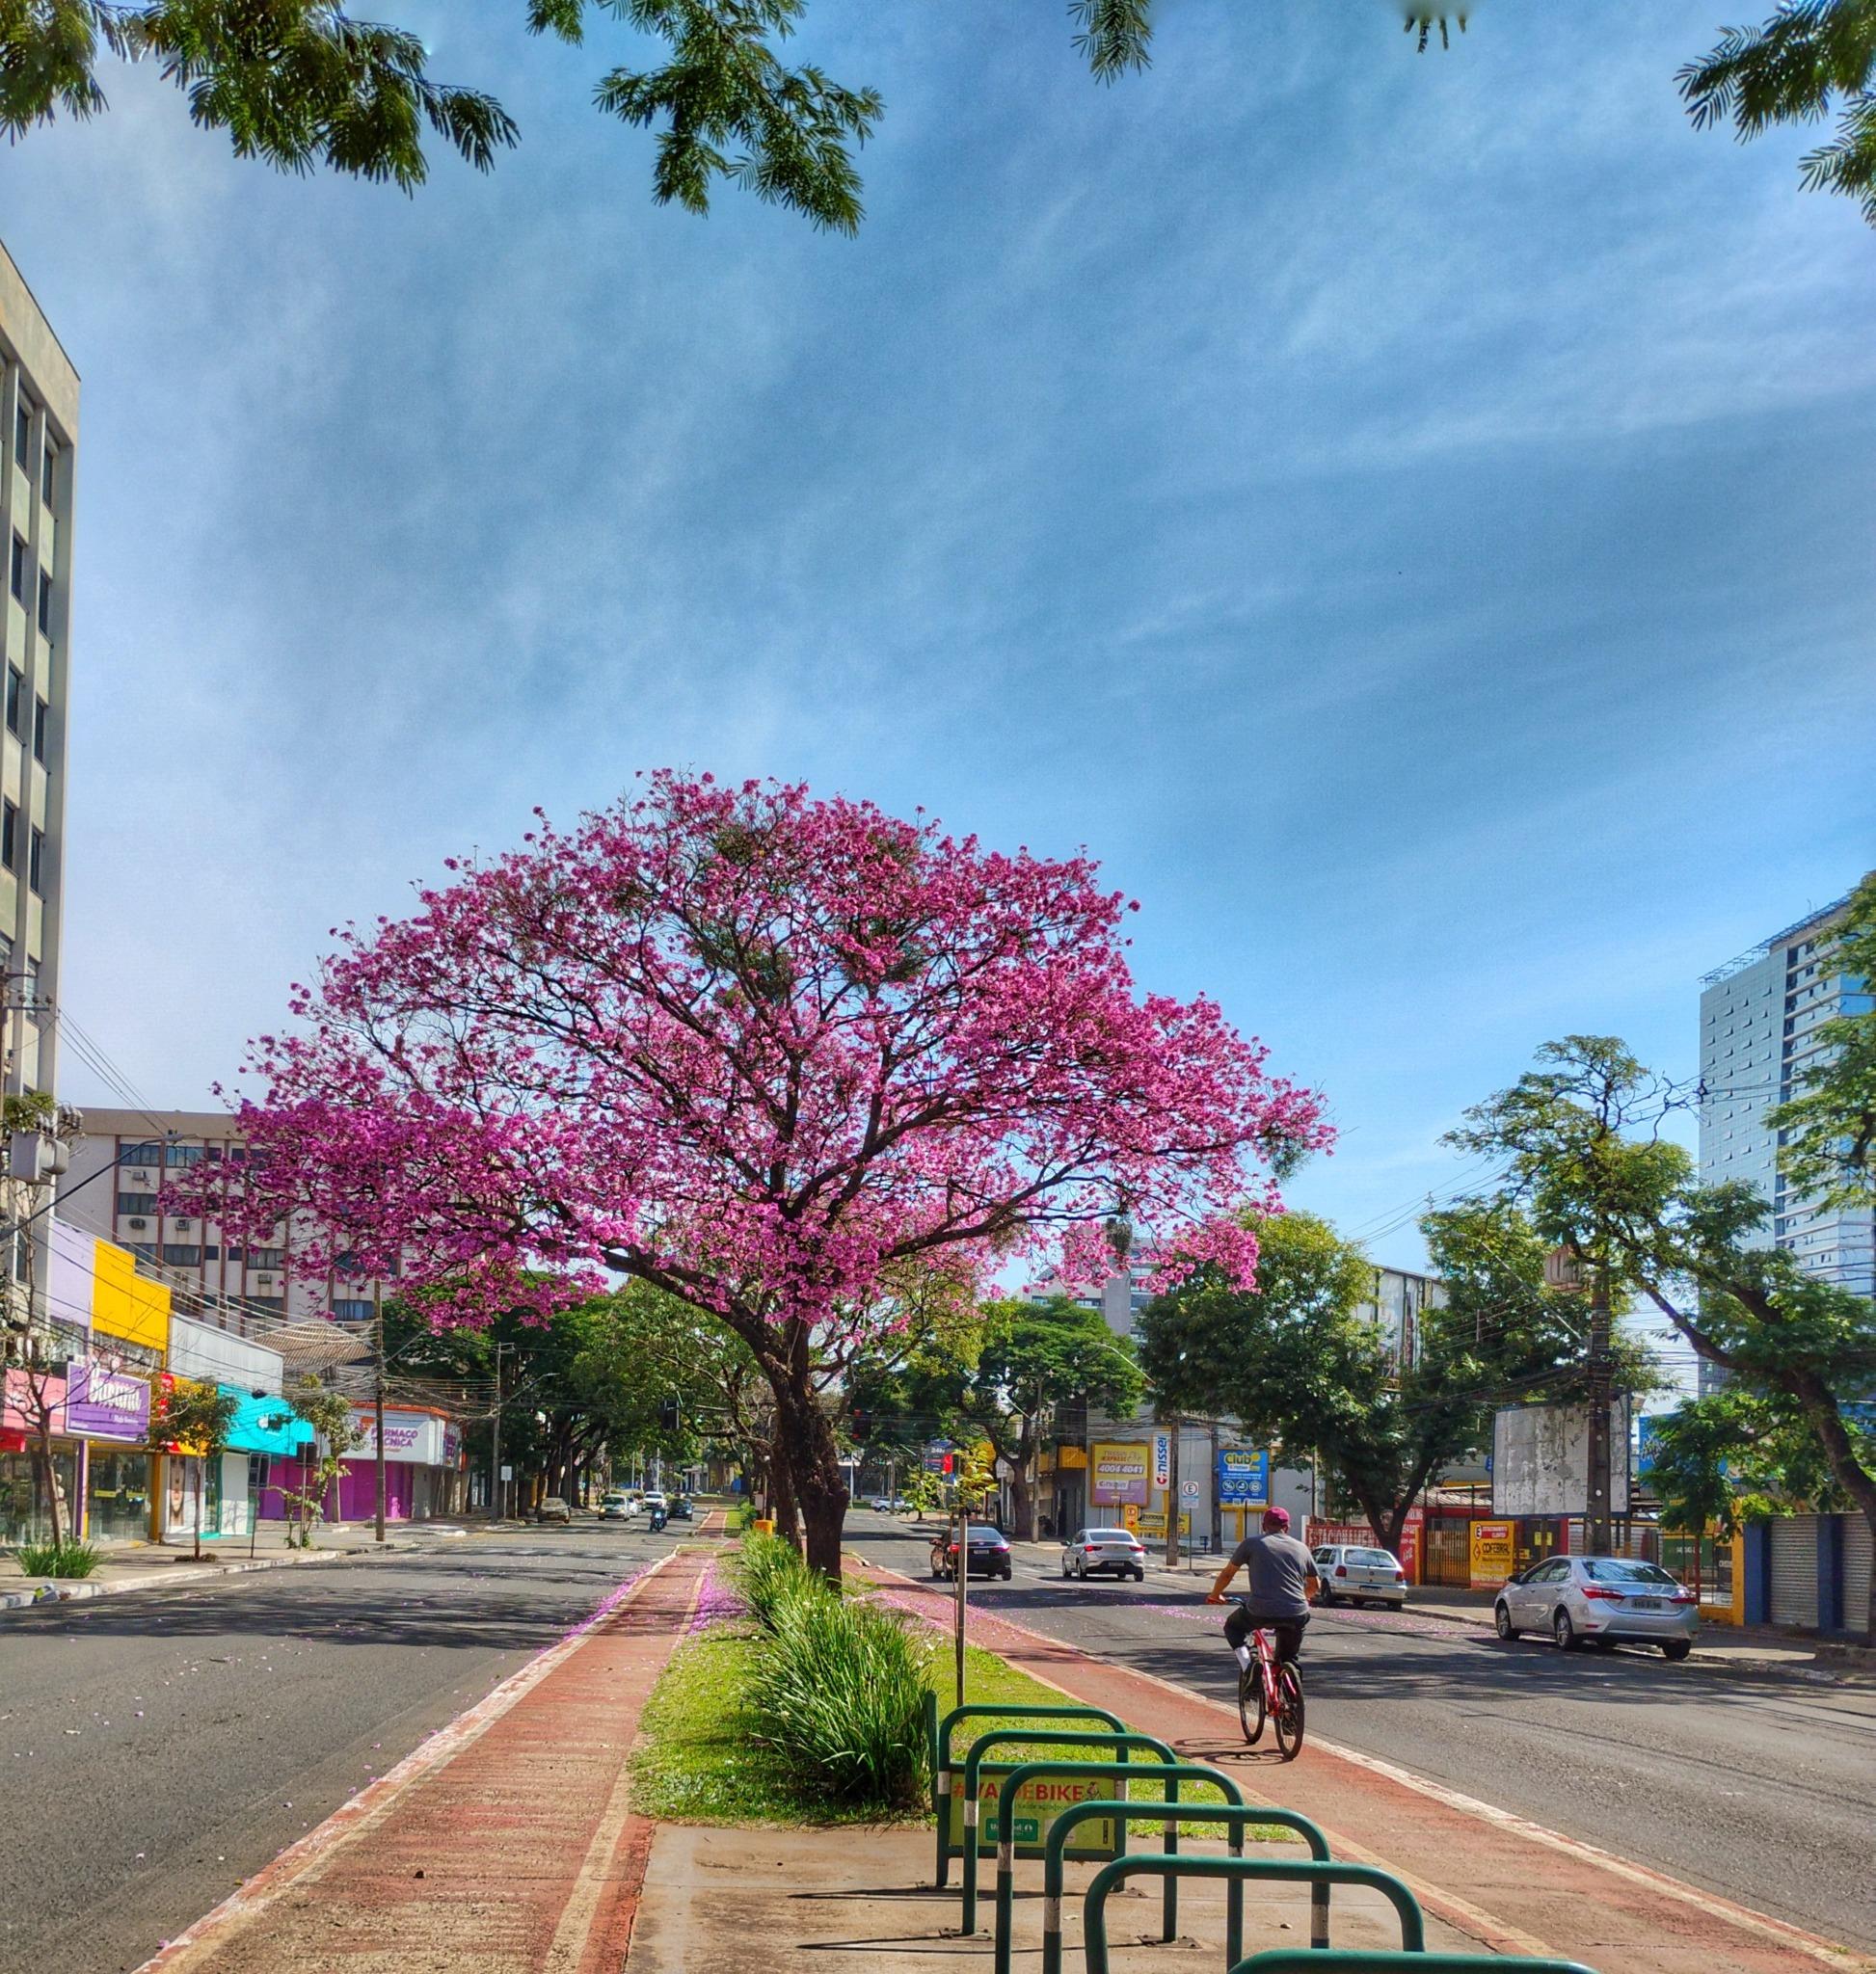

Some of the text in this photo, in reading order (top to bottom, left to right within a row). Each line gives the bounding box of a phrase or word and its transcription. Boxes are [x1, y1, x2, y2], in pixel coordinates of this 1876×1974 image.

[371, 1427, 418, 1439] FRMACO
[371, 1436, 414, 1448] TCNICA
[1224, 1454, 1252, 1465] Club
[1188, 1484, 1193, 1493] E
[1476, 1526, 1482, 1537] E
